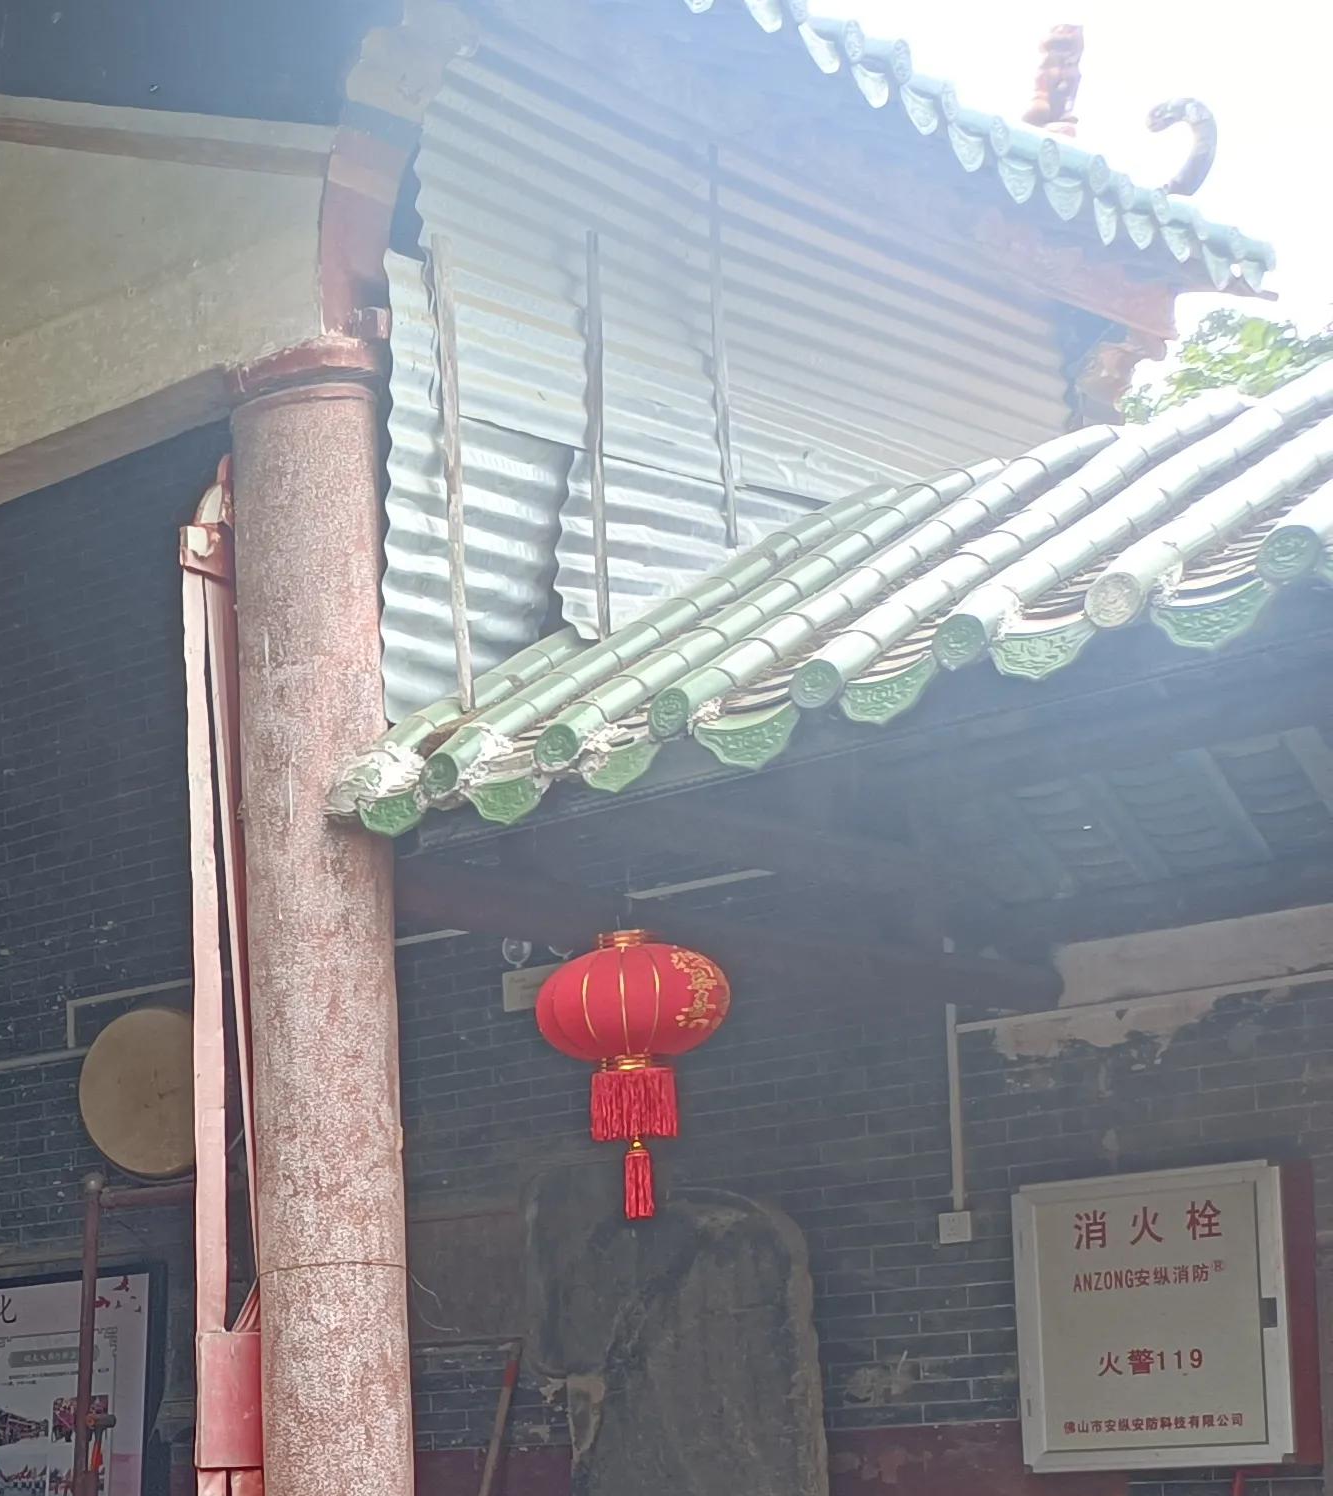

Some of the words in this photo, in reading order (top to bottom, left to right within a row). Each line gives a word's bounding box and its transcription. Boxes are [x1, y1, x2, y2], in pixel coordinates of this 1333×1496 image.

[1073, 1200, 1222, 1249] 消火栓
[1097, 1348, 1204, 1377] 火警119
